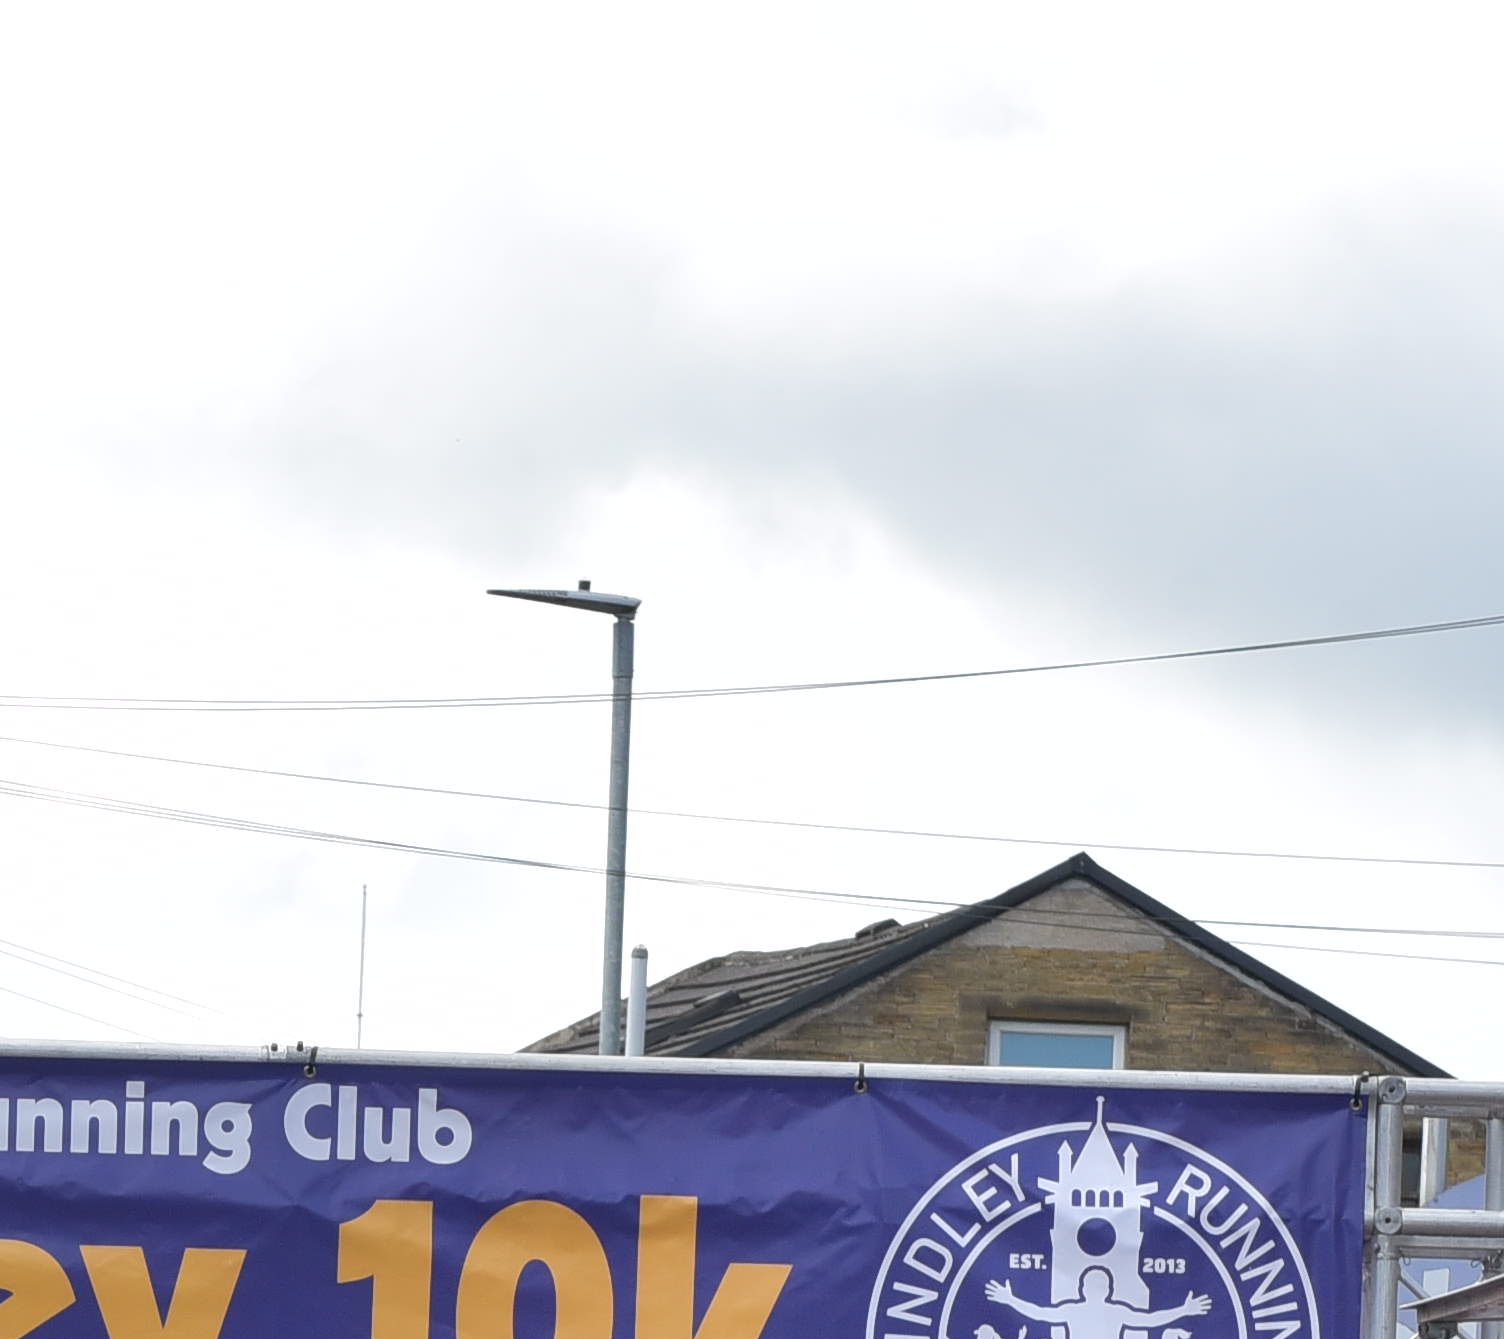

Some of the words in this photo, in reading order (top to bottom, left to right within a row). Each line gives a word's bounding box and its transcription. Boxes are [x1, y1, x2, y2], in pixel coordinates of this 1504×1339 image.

[283, 1082, 473, 1165] Club
[1009, 1254, 1047, 1271] EST.
[1142, 1256, 1186, 1275] 2013
